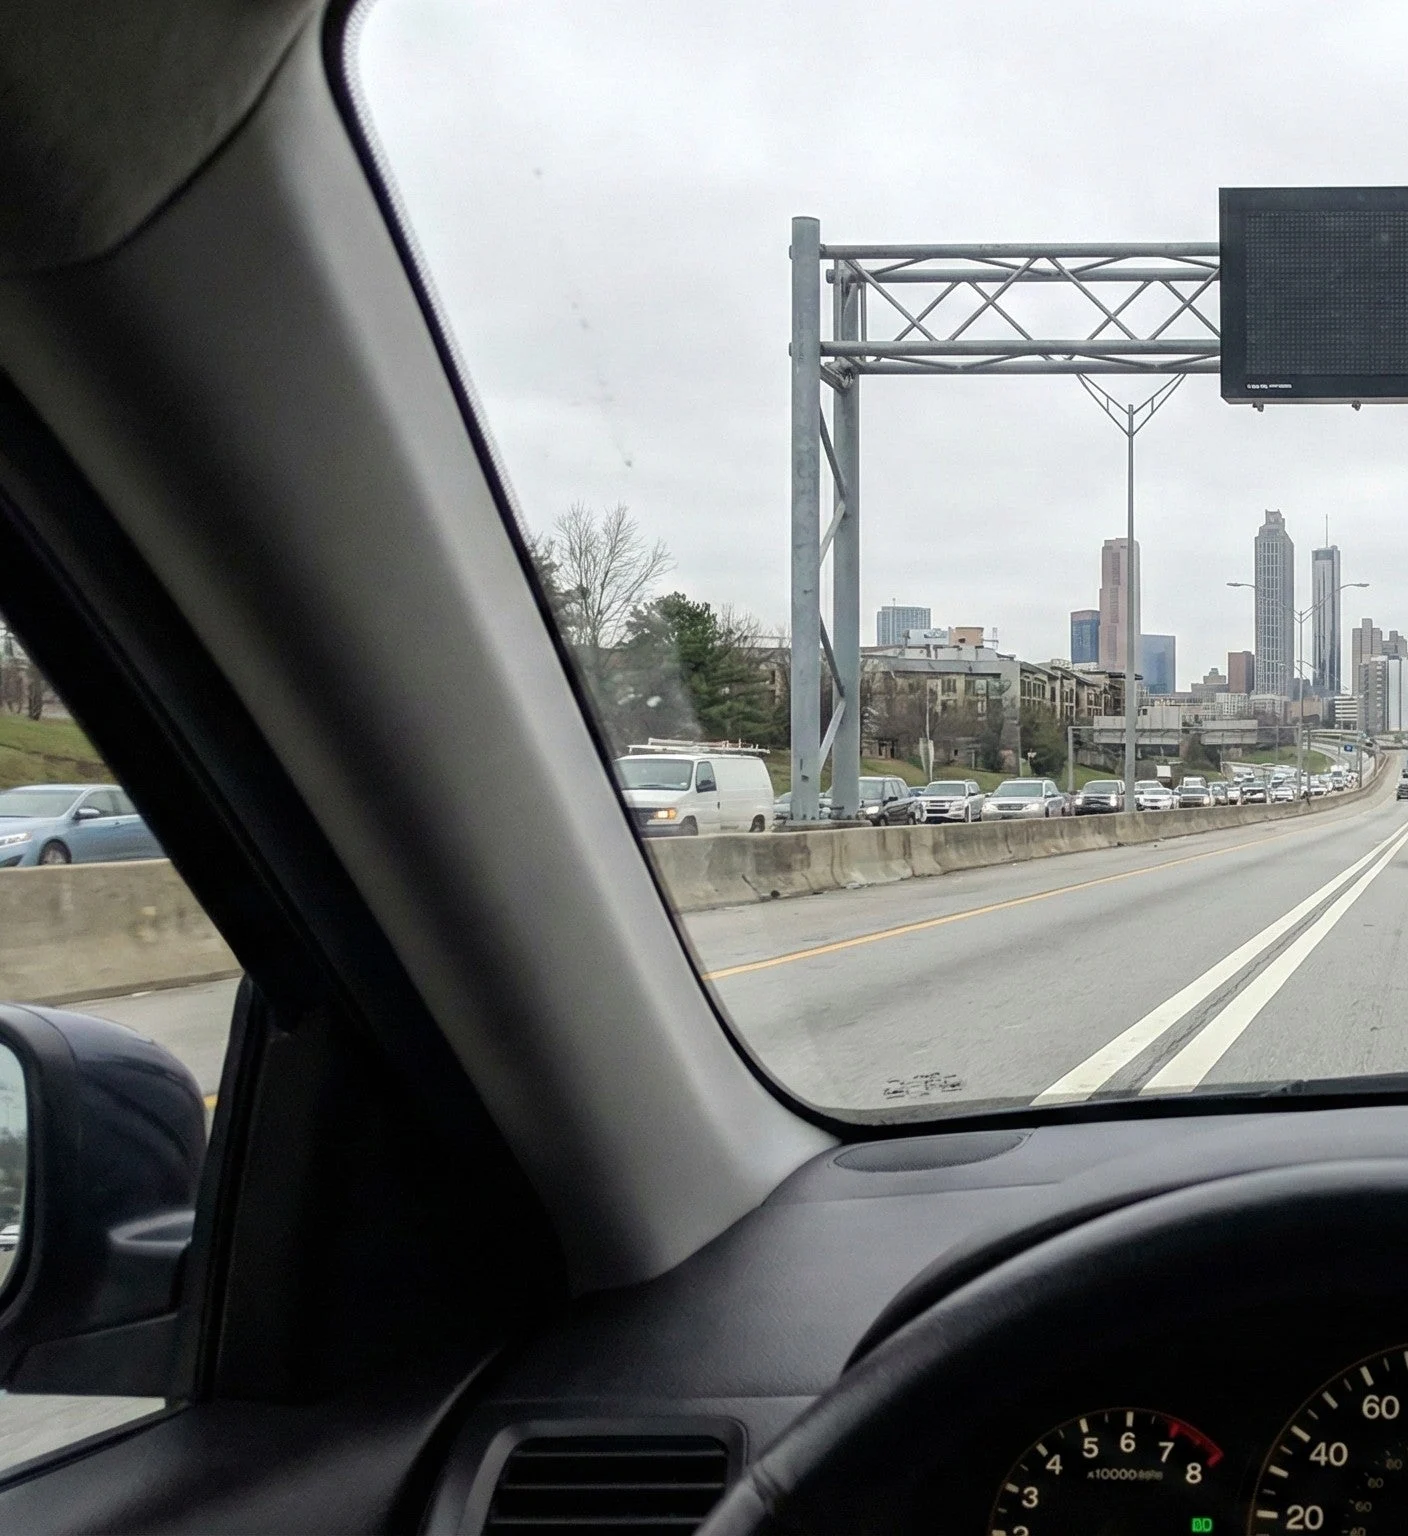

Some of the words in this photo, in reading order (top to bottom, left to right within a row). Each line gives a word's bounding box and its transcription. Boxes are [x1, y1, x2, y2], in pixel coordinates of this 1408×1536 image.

[1362, 1395, 1400, 1420] 60
[1082, 1437, 1099, 1458] 5
[1120, 1432, 1136, 1453] 6
[1158, 1442, 1175, 1463] 7
[1046, 1454, 1063, 1475] 4
[1309, 1442, 1349, 1467] 40
[1185, 1463, 1202, 1484] 8
[1022, 1486, 1039, 1508] 3
[1285, 1504, 1324, 1530] 20
